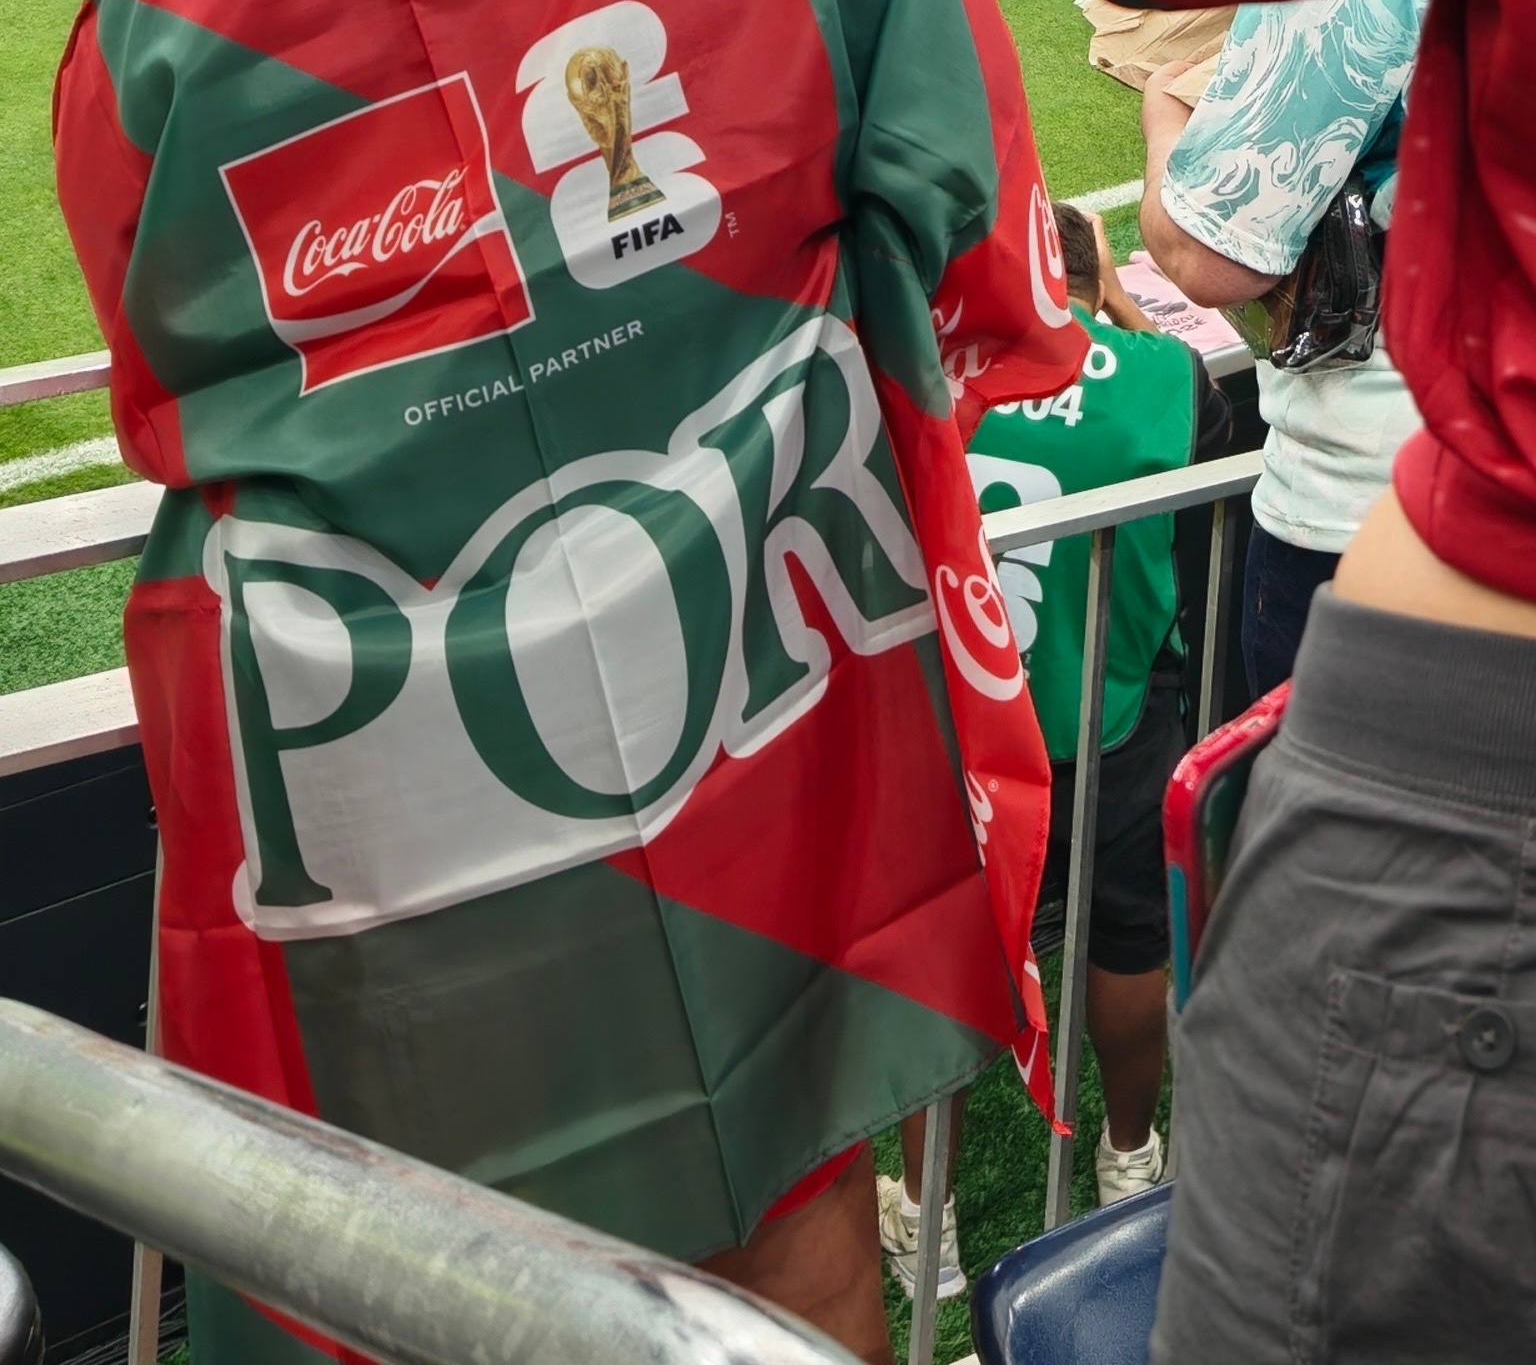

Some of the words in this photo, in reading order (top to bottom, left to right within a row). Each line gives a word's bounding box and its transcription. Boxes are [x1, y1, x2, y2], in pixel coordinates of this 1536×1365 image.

[283, 165, 469, 298] Coca-Cola
[611, 212, 685, 261] FIFA
[404, 374, 525, 426] OFFICIAL
[529, 319, 645, 383] PARTNER
[215, 324, 932, 921] POR
